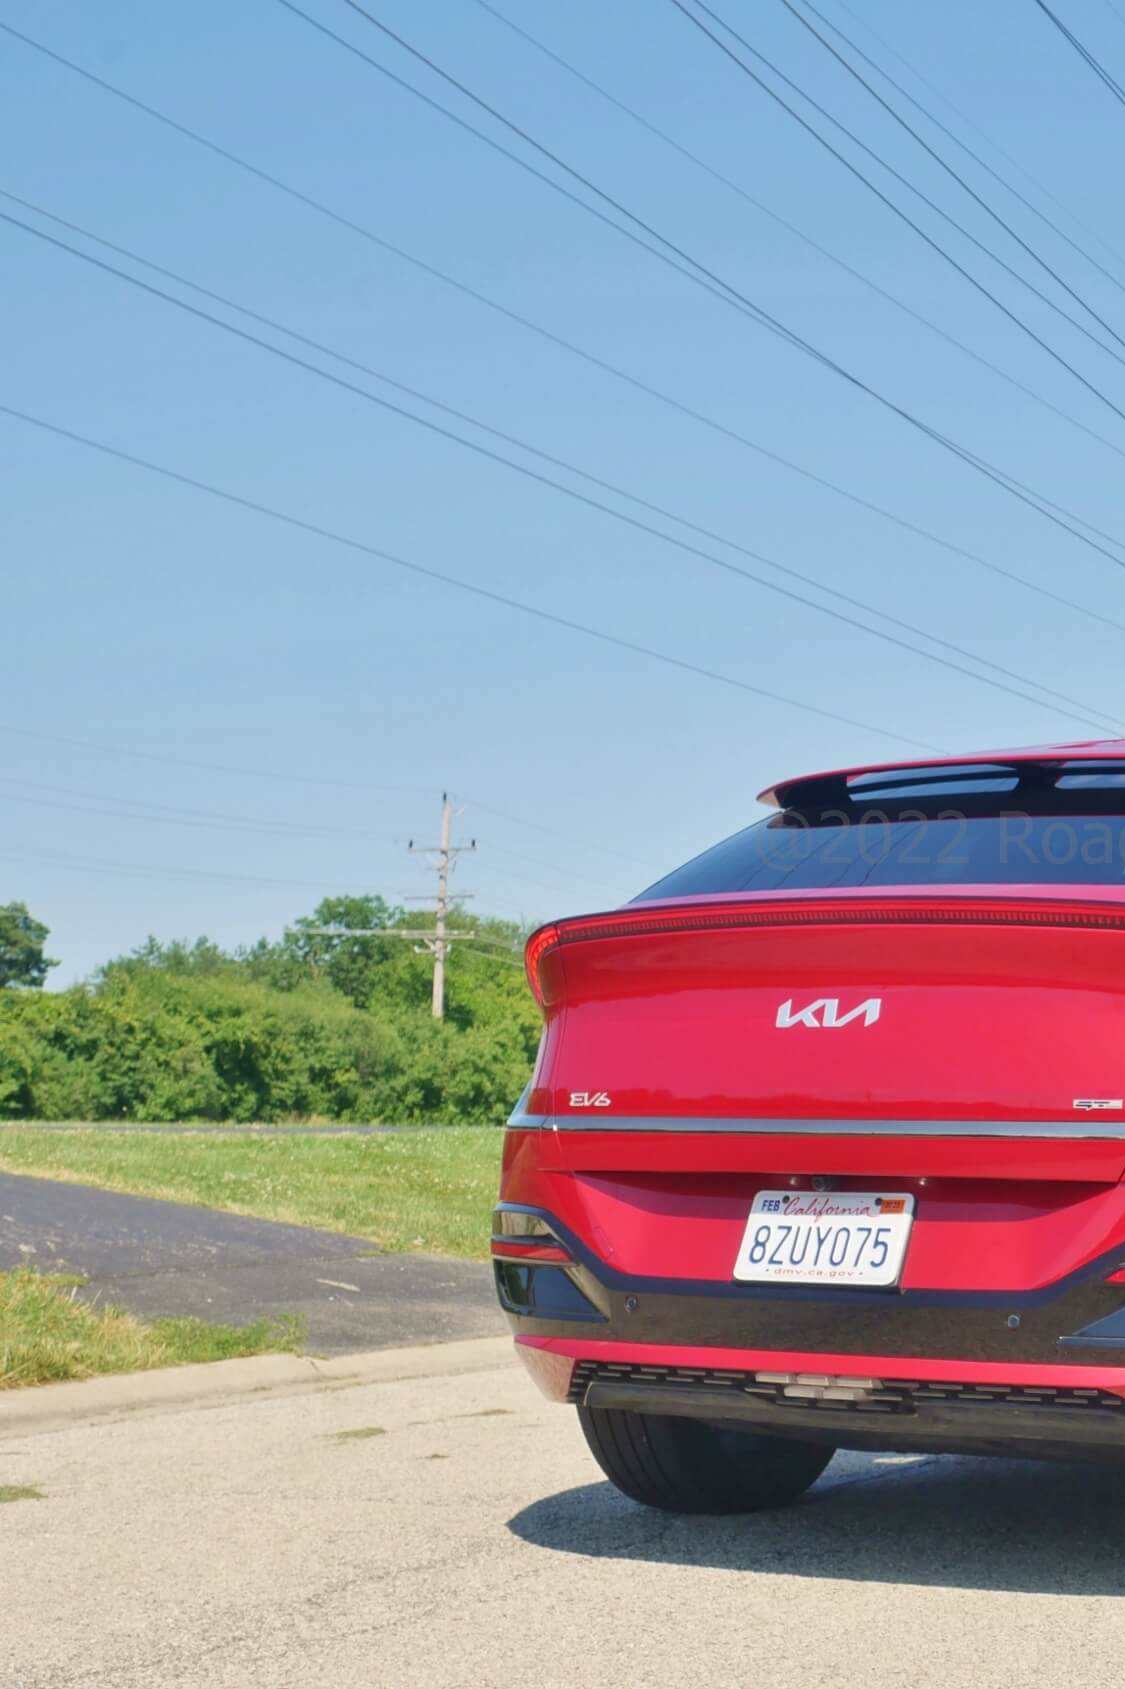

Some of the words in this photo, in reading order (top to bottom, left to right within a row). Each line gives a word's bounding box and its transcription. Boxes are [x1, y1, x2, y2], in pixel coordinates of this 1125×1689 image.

[775, 998, 882, 1028] KIA
[569, 1092, 611, 1107] EV6
[761, 1199, 780, 1212] FEB
[783, 1197, 874, 1221] California
[748, 1225, 891, 1268] 8ZUY075
